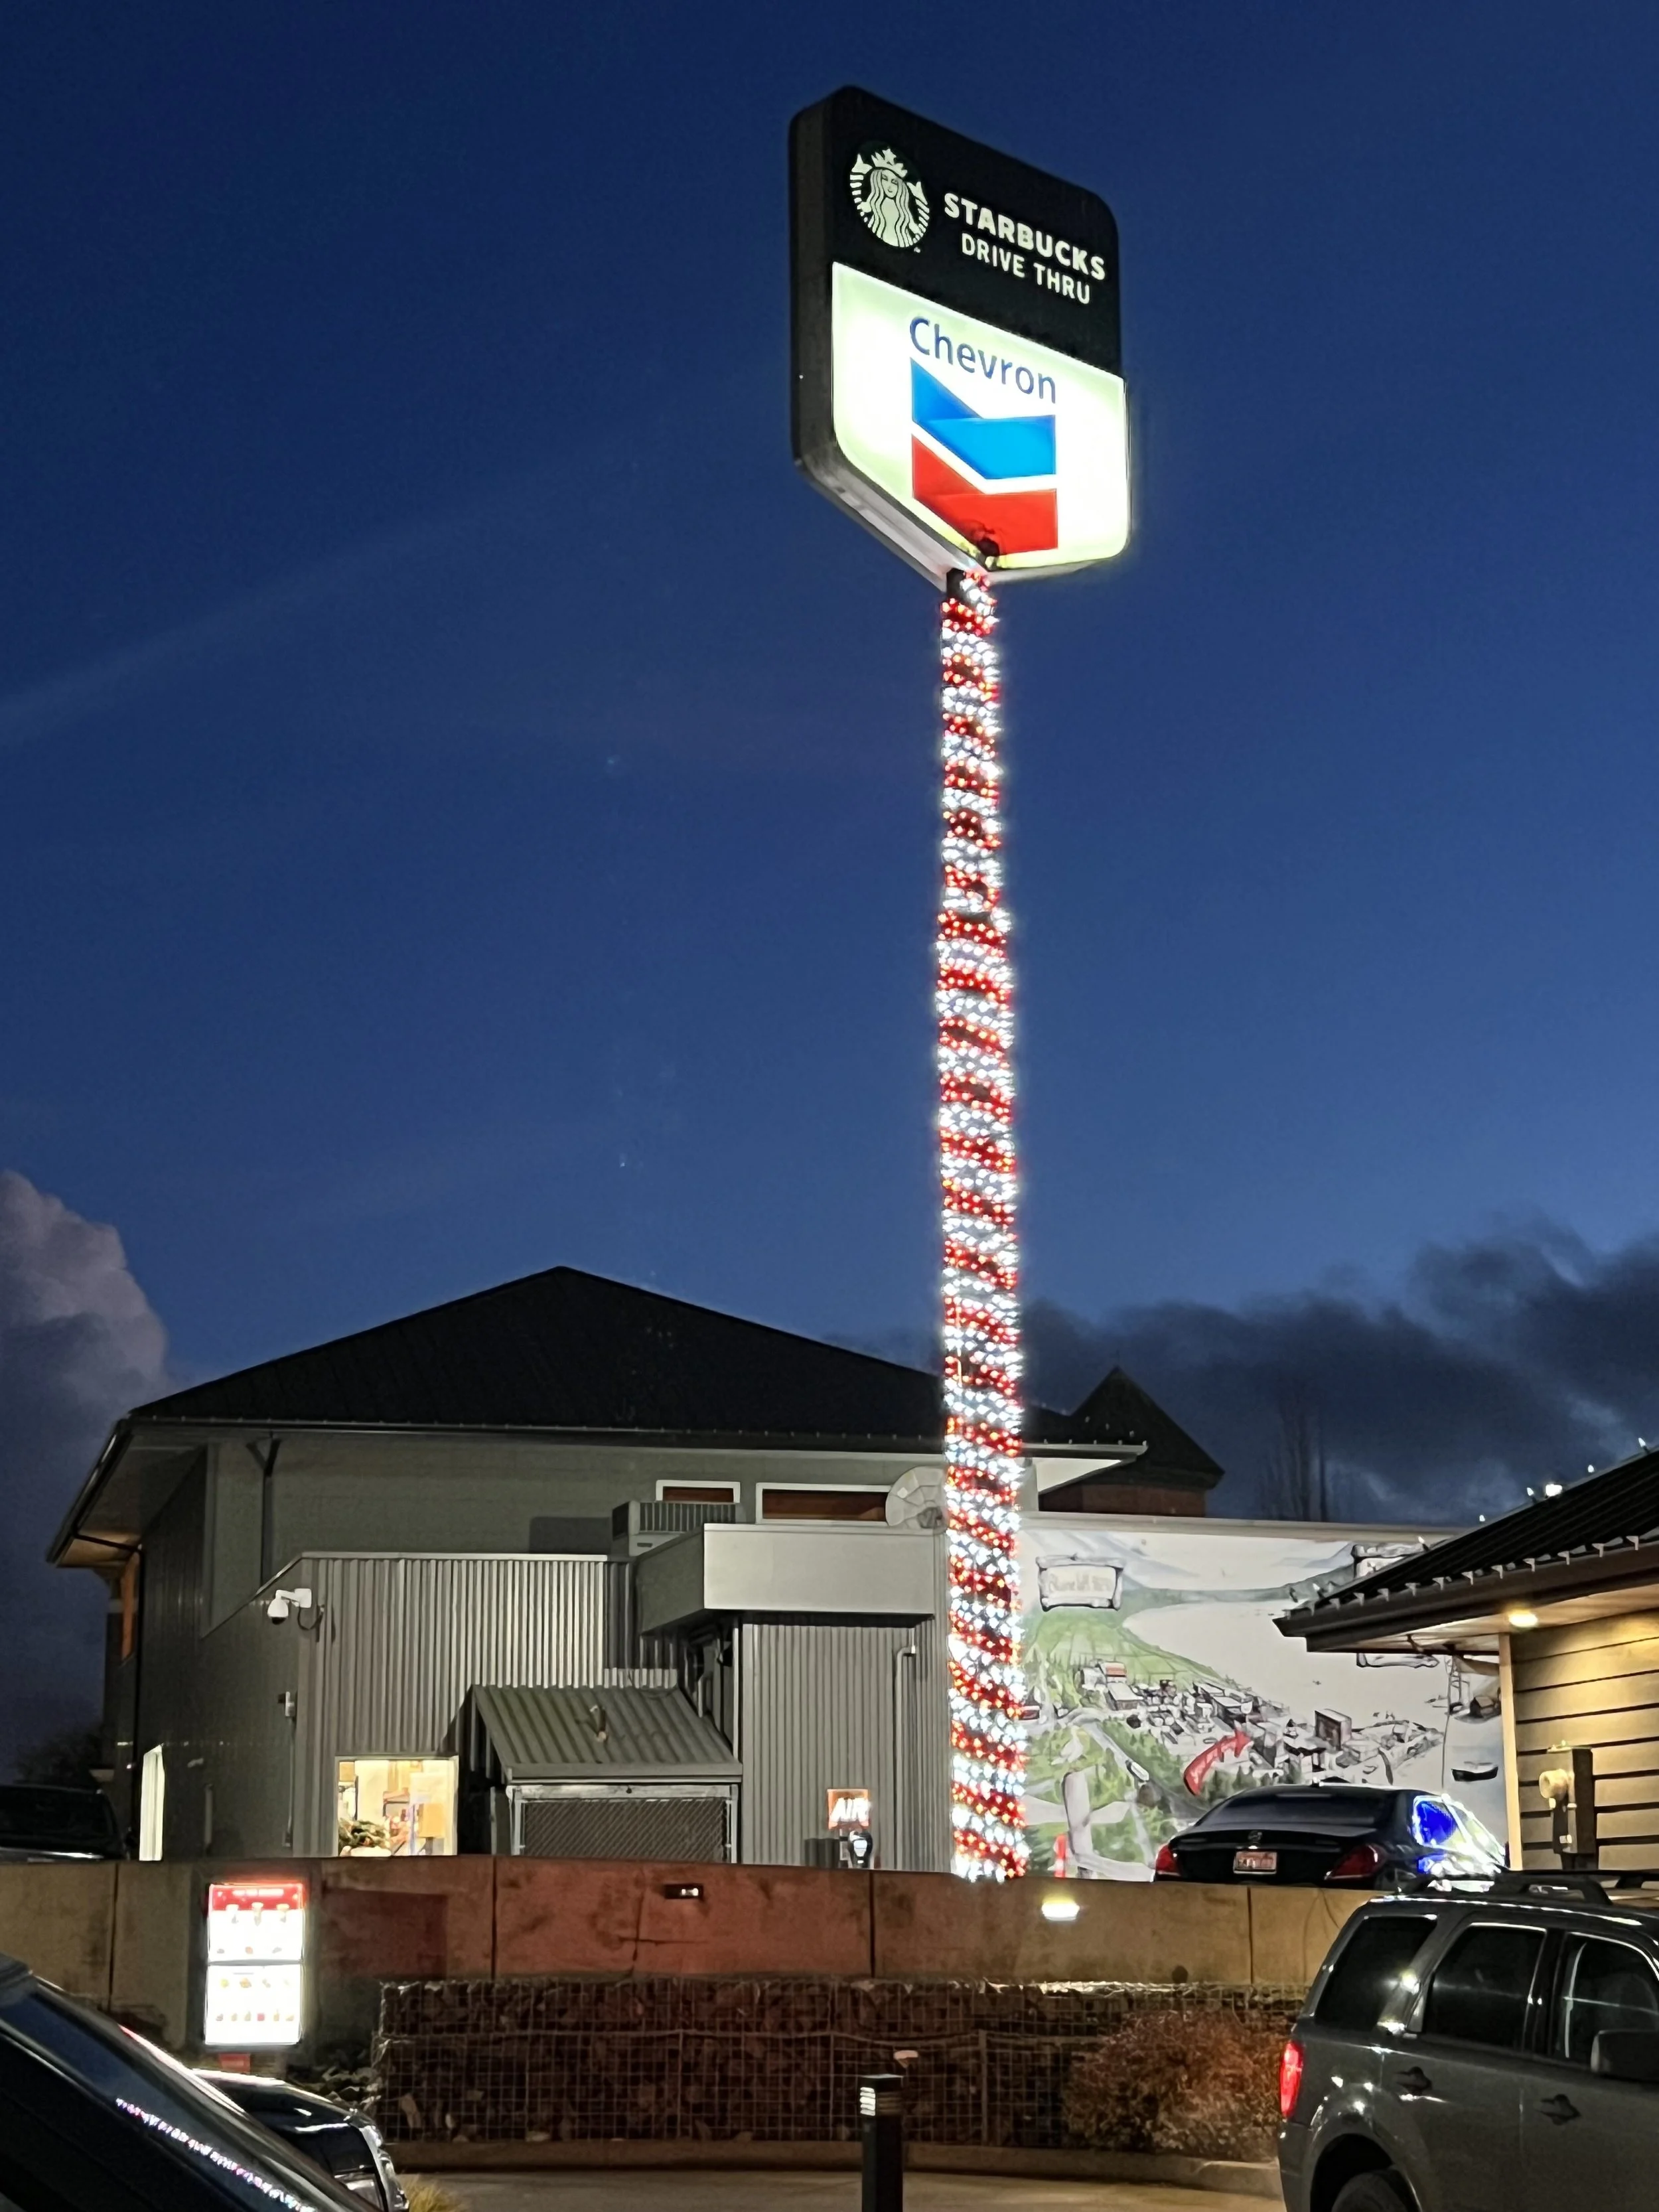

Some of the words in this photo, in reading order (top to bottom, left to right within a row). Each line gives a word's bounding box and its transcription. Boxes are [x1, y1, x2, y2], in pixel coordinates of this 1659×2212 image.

[944, 192, 1106, 281] STARBUCKS
[961, 232, 1025, 279] DRIVE
[1033, 262, 1091, 305] THRU
[909, 317, 1056, 404] Chevron
